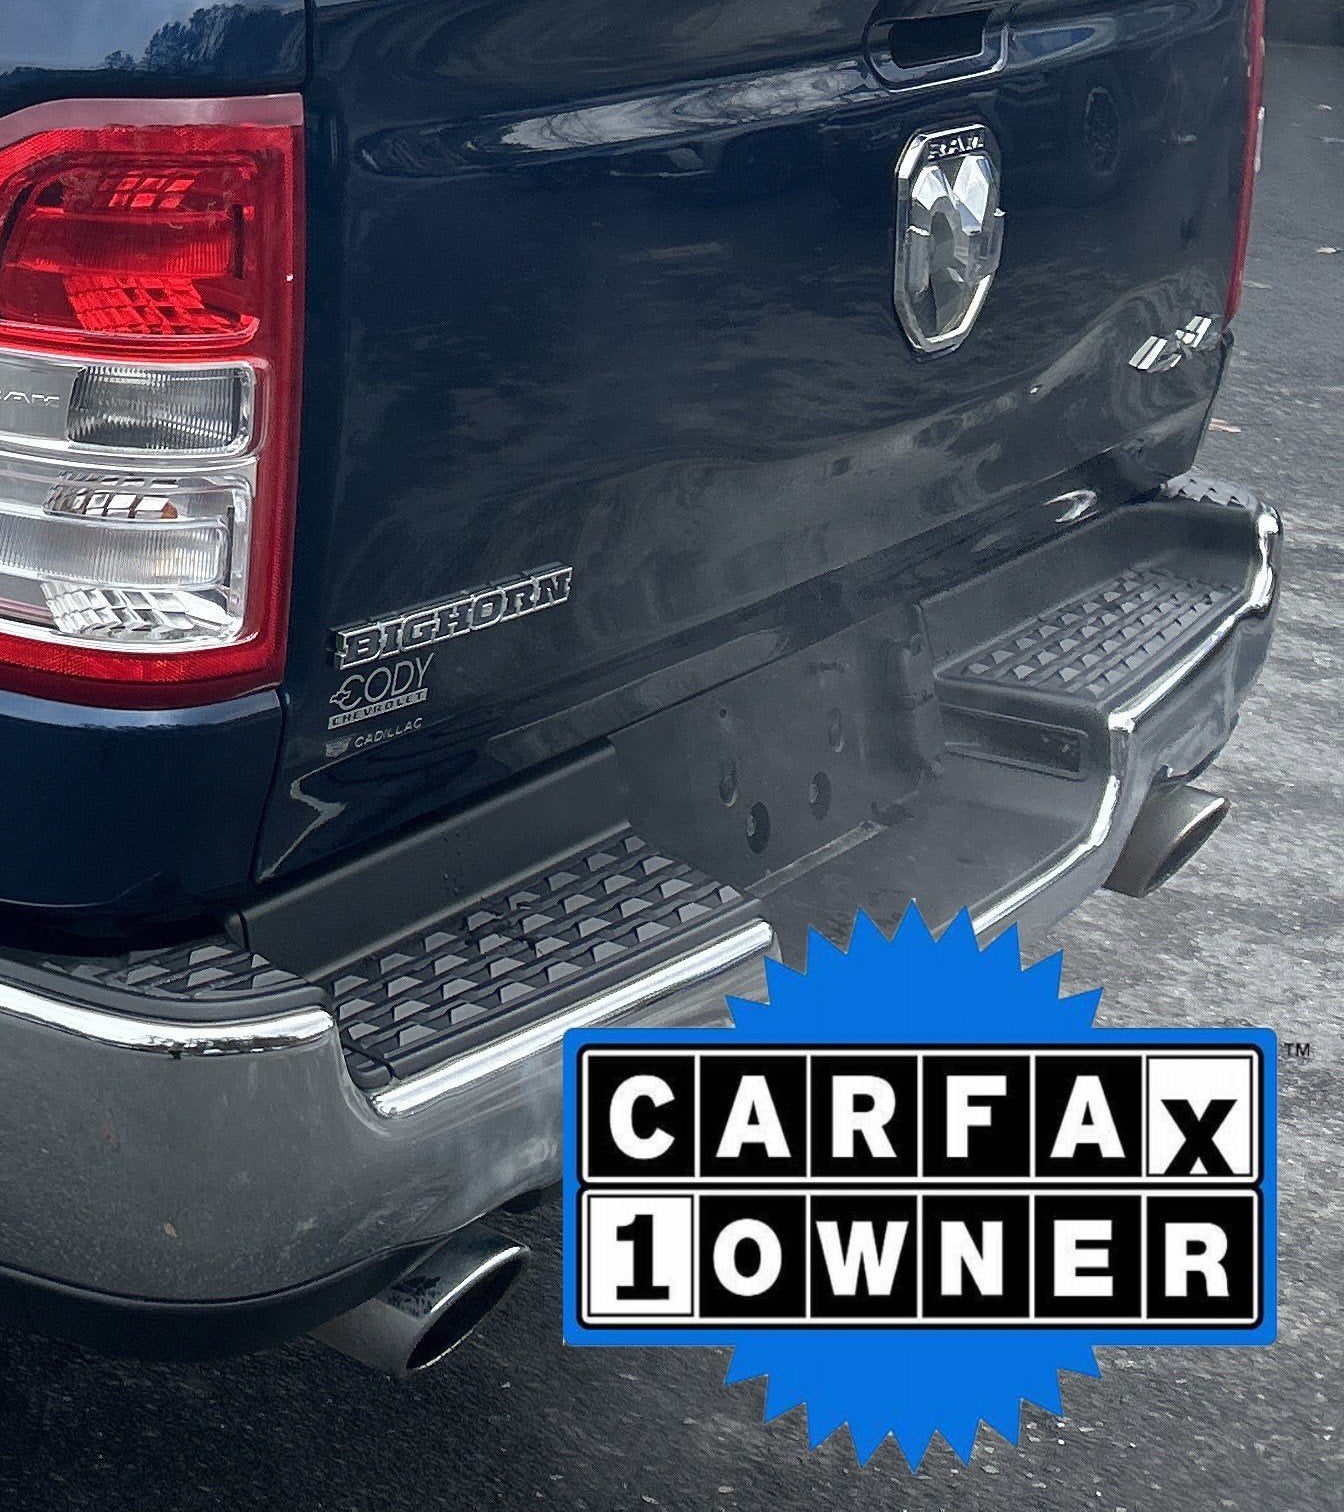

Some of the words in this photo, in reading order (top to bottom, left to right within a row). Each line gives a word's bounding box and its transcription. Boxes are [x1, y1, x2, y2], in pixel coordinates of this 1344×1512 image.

[330, 652, 435, 710] CODY
[330, 691, 426, 728] CHEVROLET
[354, 717, 423, 748] CADILLAC
